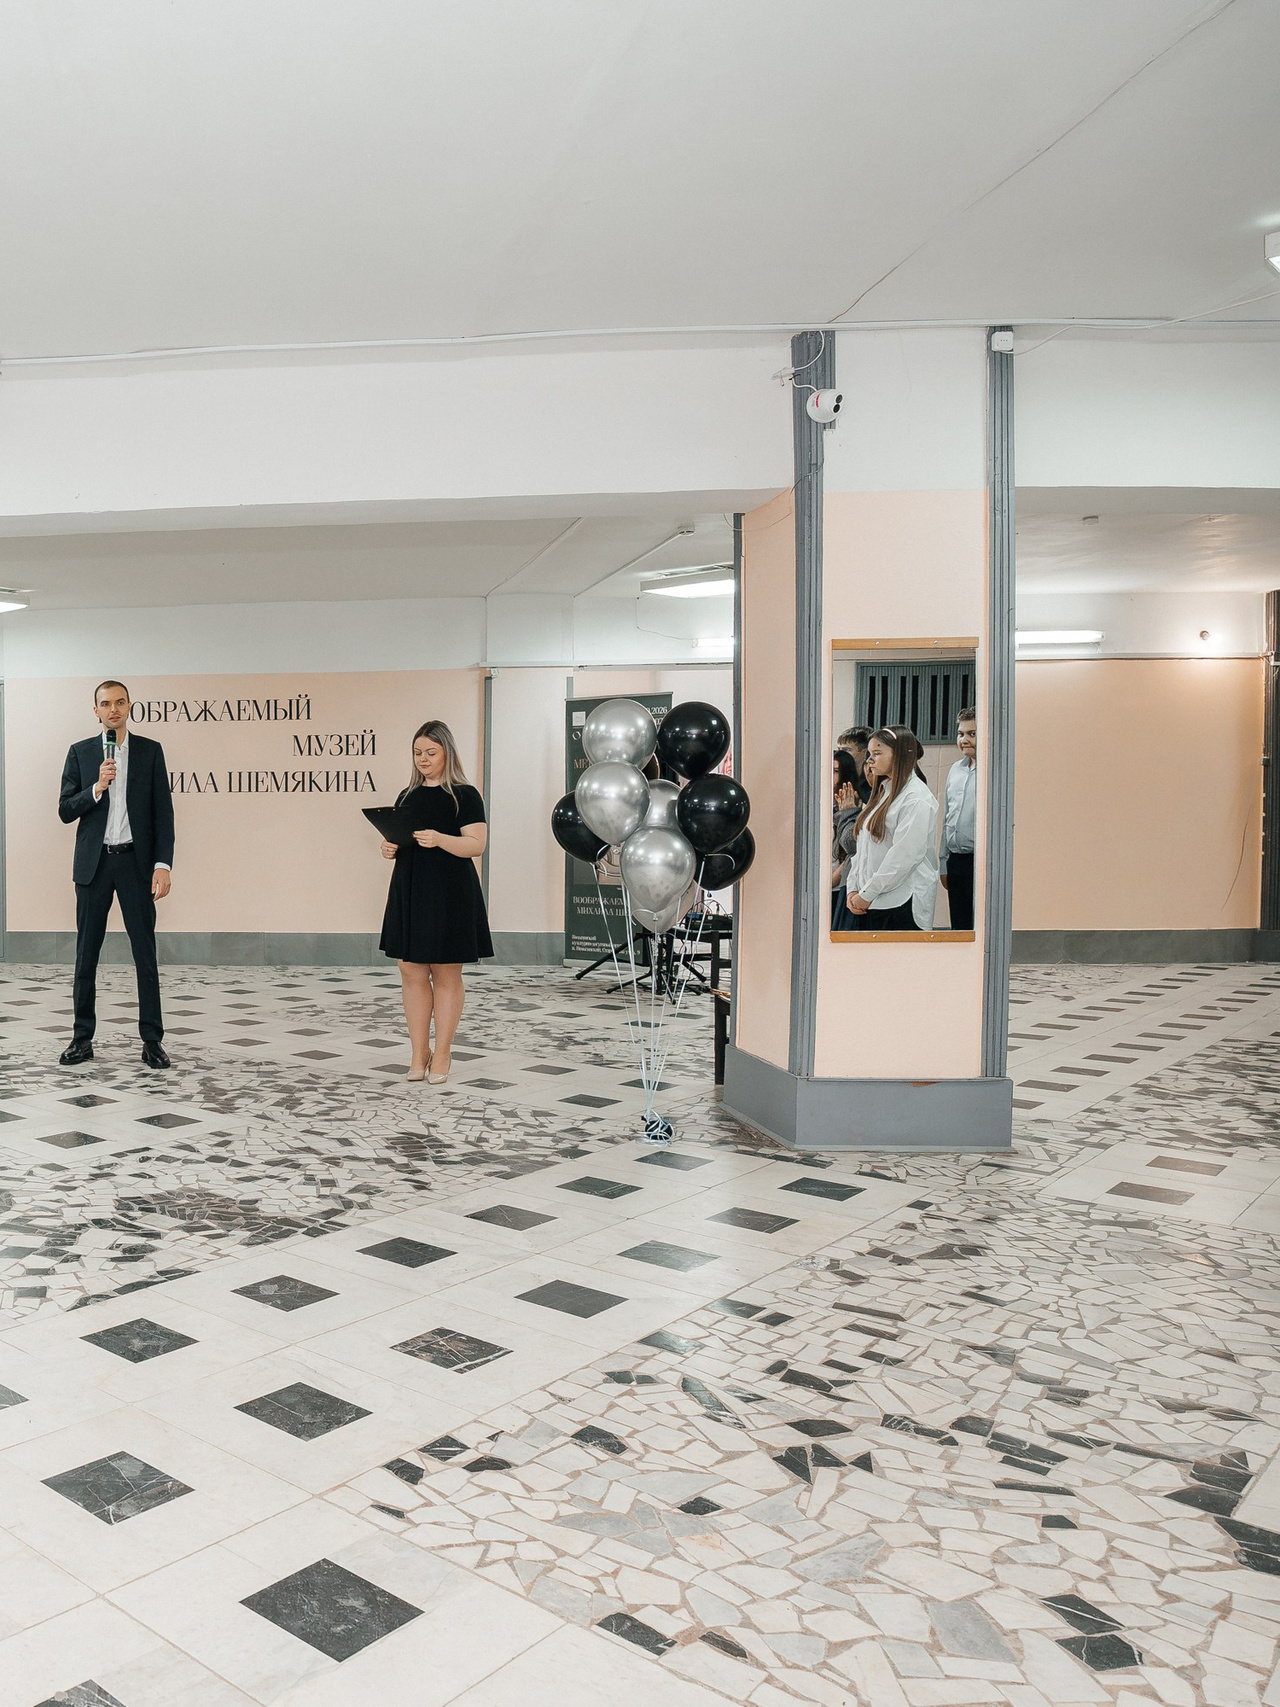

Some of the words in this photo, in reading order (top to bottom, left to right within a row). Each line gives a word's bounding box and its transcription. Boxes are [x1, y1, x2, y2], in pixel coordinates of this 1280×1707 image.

[99, 693, 312, 724] ОБРАЖАЕМЫЙ
[292, 729, 377, 757] МУЗЕЙ
[227, 770, 377, 793] ШЕМЯКИНА
